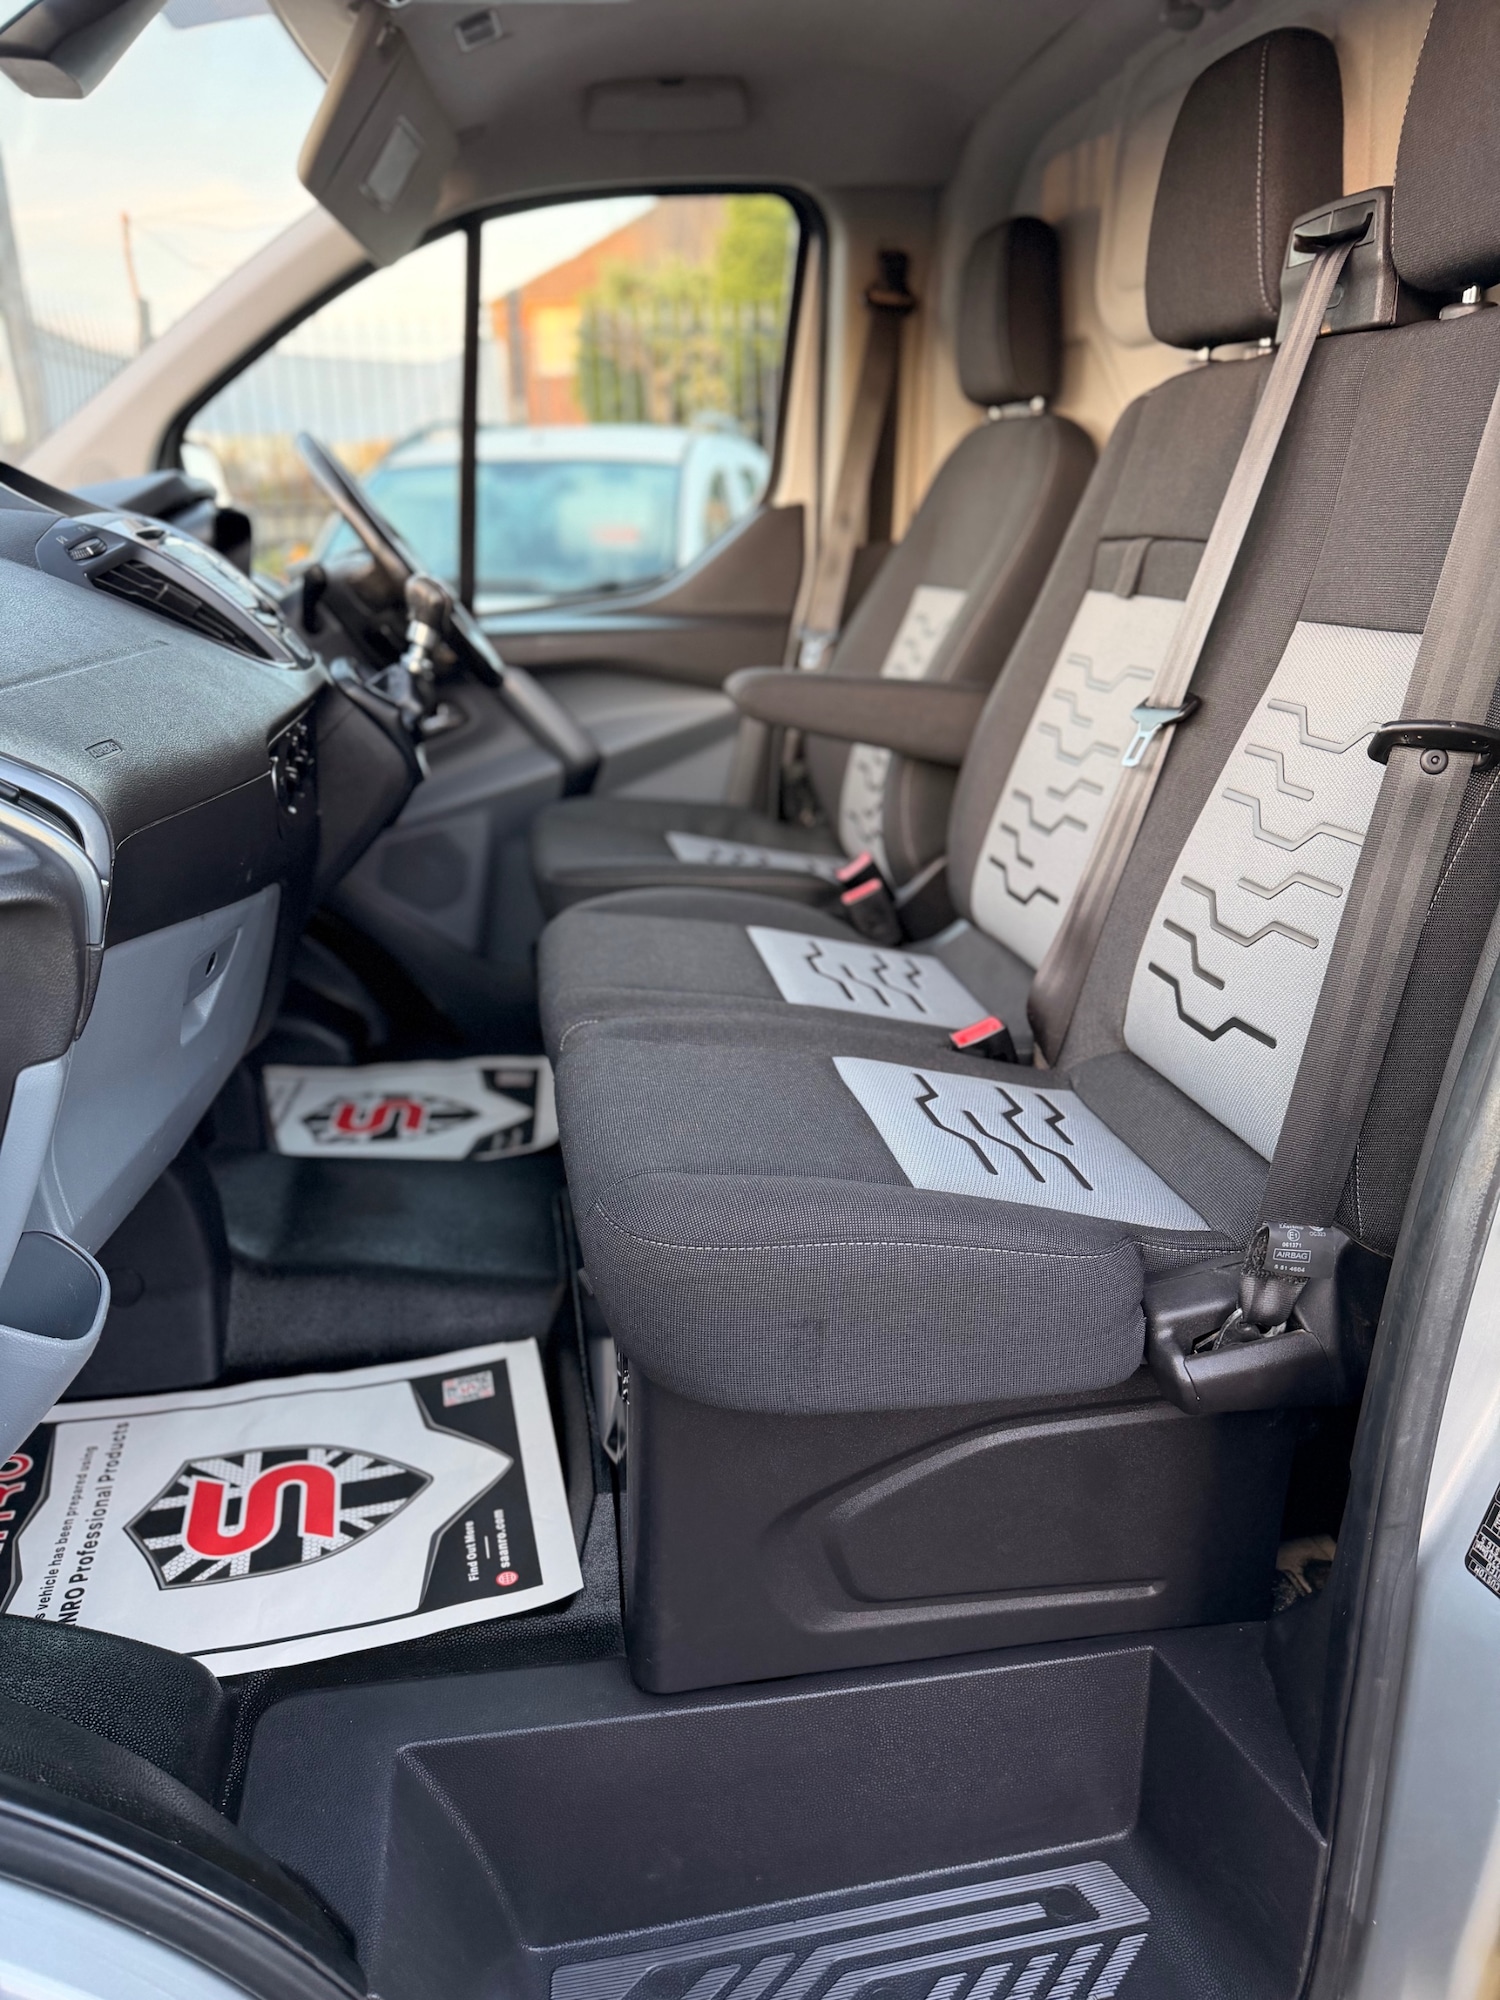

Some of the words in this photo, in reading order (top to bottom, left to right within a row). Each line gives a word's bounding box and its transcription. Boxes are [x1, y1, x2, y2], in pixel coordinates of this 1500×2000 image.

[1276, 1251, 1308, 1259] AIRBAG
[81, 1445, 98, 1473] using
[98, 1421, 130, 1483] Products
[66, 1473, 88, 1516] prepared
[55, 1518, 75, 1546] been
[69, 1484, 113, 1584] Professional
[493, 1508, 511, 1569] saanro.com
[49, 1546, 66, 1567] has
[466, 1543, 477, 1560] Out
[467, 1560, 480, 1582] Find
[1474, 1565, 1500, 1591] CUSTOM
[37, 1569, 59, 1610] vehicle
[58, 1587, 85, 1626] NRO
